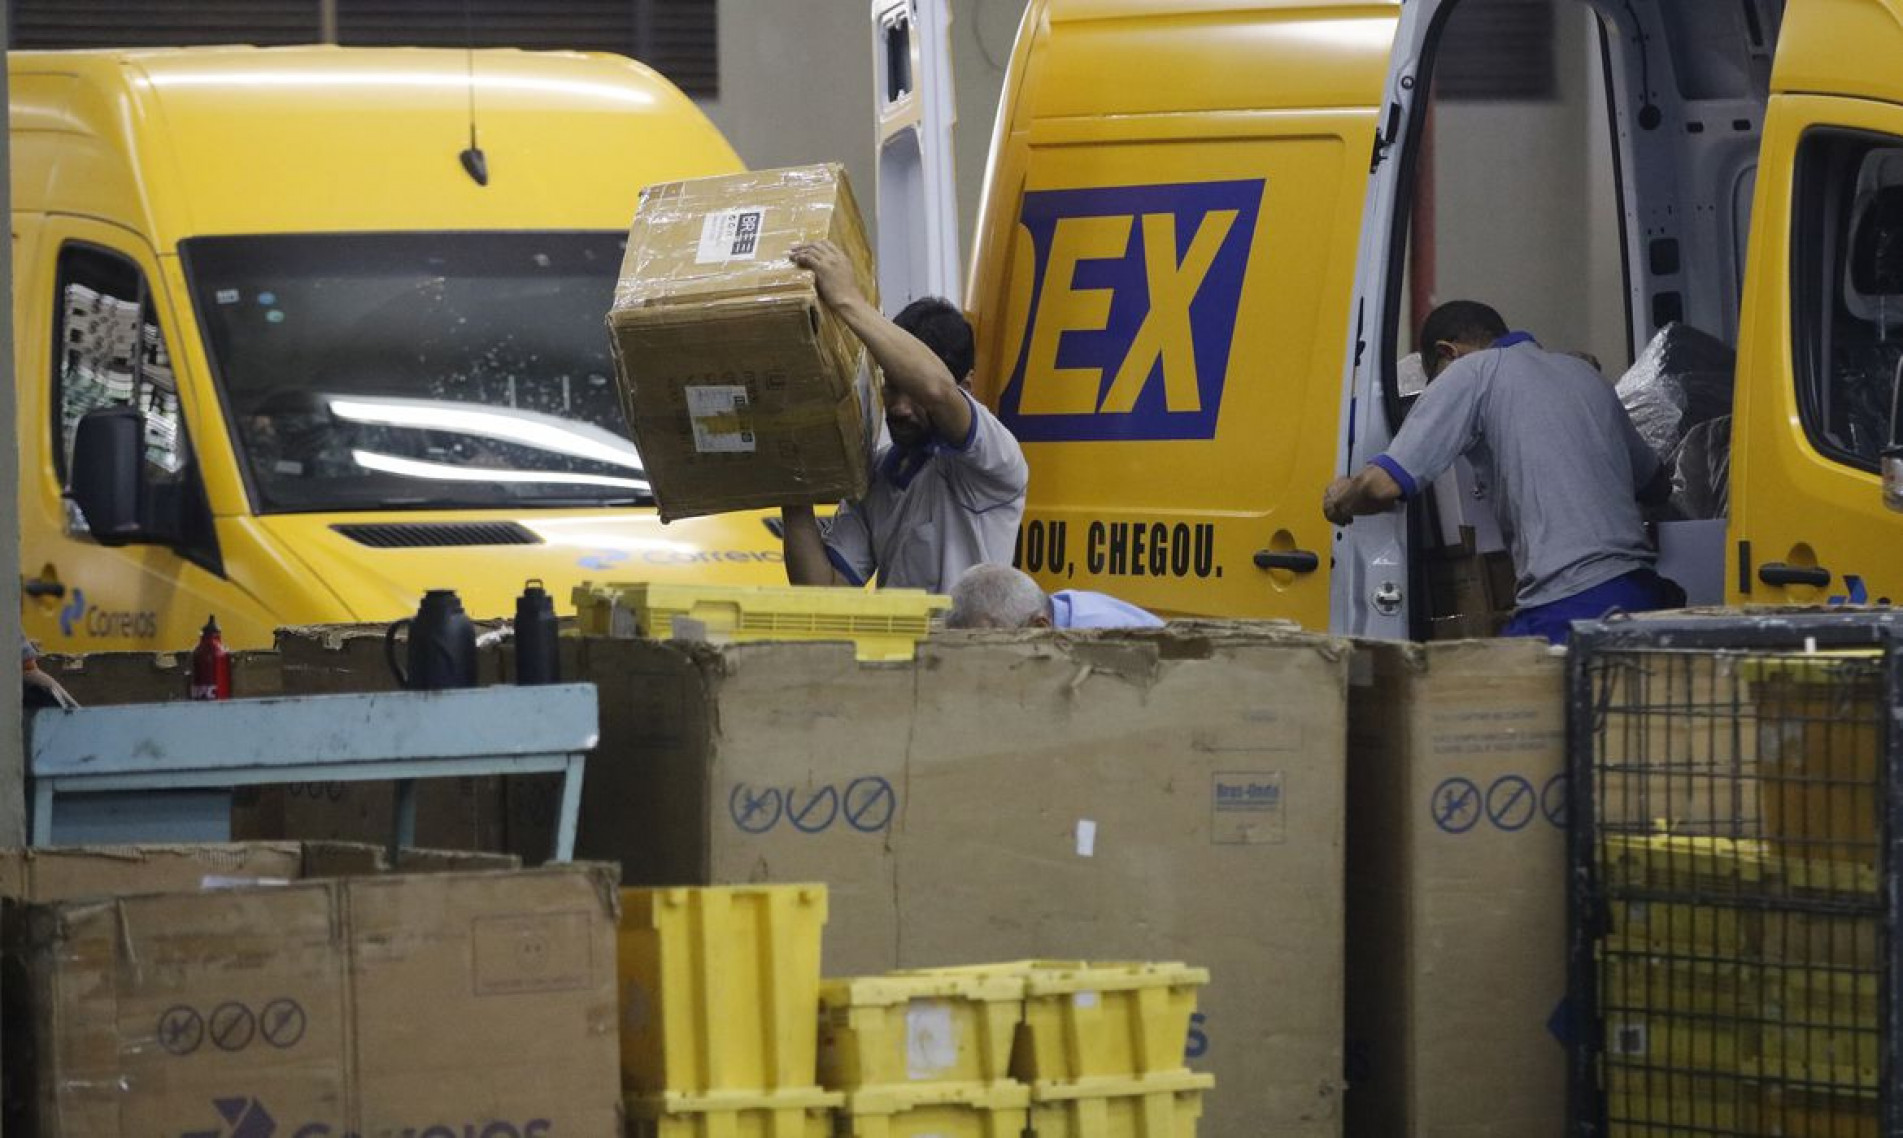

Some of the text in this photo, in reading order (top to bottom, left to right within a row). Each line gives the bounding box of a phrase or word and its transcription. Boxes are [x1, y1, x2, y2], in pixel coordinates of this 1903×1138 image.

[642, 550, 785, 563] Correio
[1087, 520, 1223, 578] CHEGOU.
[86, 605, 157, 638] Correios
